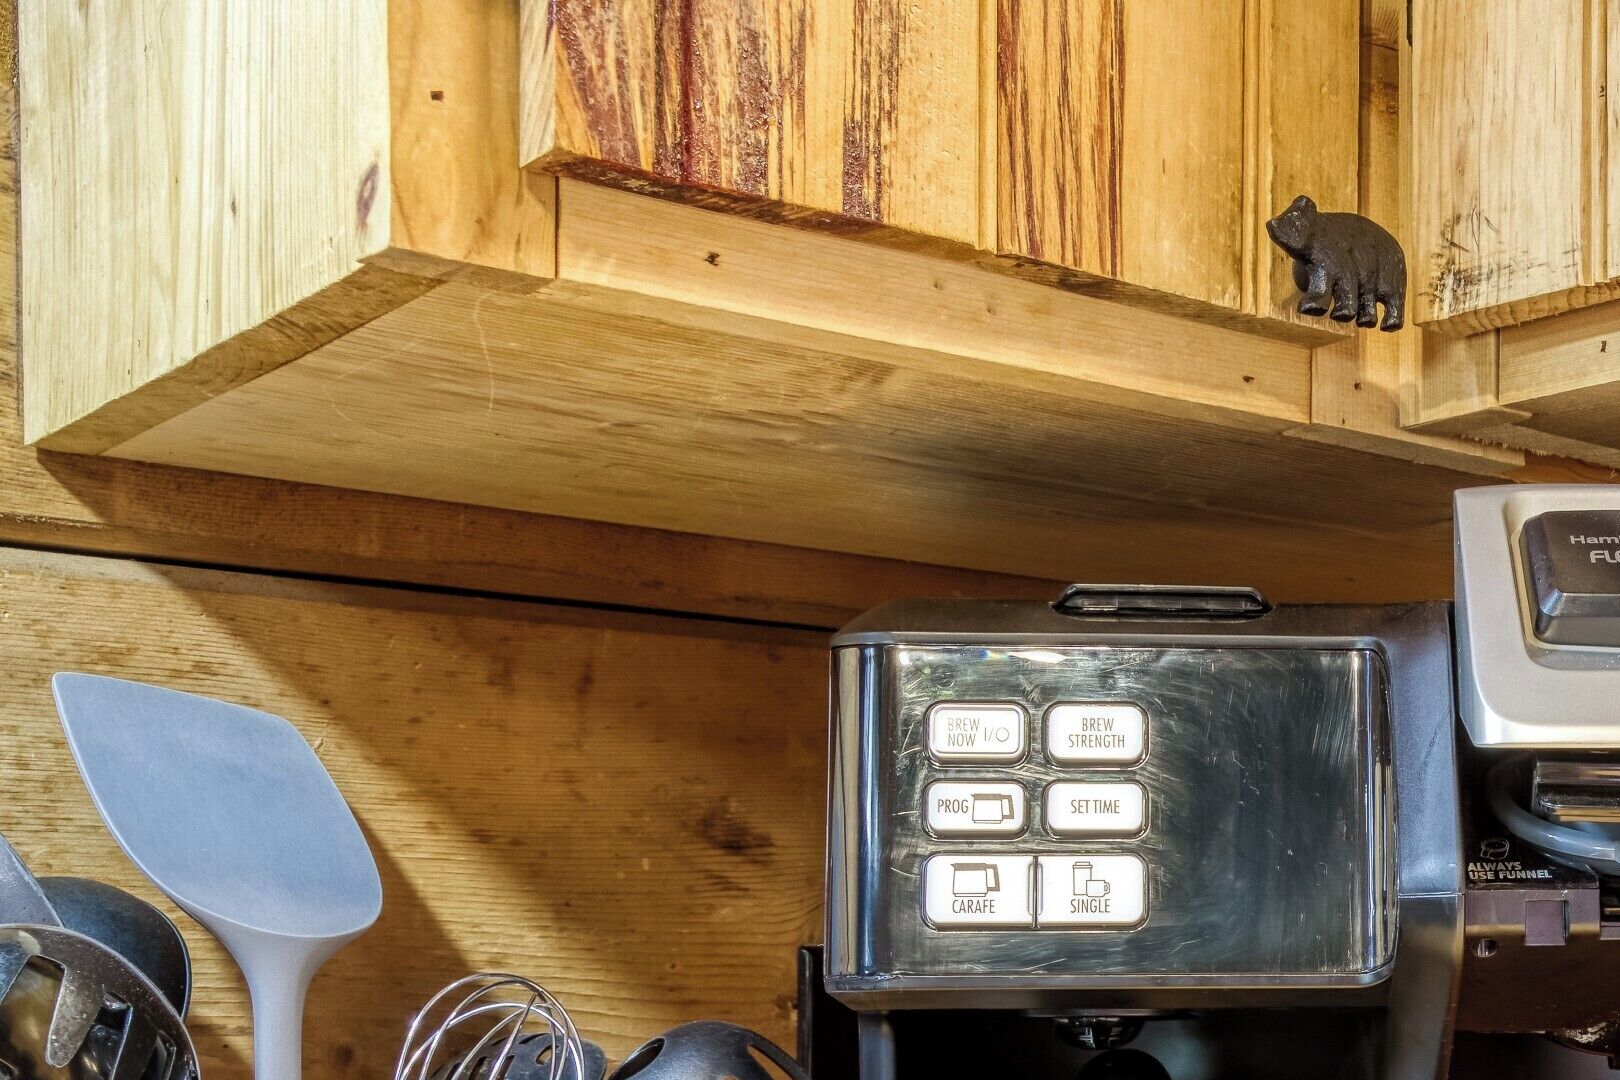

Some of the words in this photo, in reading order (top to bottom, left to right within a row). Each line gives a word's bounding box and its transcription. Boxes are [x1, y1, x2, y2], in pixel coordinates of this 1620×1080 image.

[947, 717, 980, 732] BREW
[1081, 717, 1115, 731] BREW
[947, 733, 976, 747] NOW
[1068, 734, 1126, 749] STRENGTH
[937, 799, 969, 814] PROG
[1071, 799, 1091, 814] SET
[1093, 799, 1120, 814] TIME
[1468, 861, 1522, 872] ALWAYS
[1468, 871, 1495, 880] USE
[1498, 869, 1553, 879] FUNNEL
[952, 899, 996, 914] CARAFE
[1070, 898, 1111, 914] SINGLE
